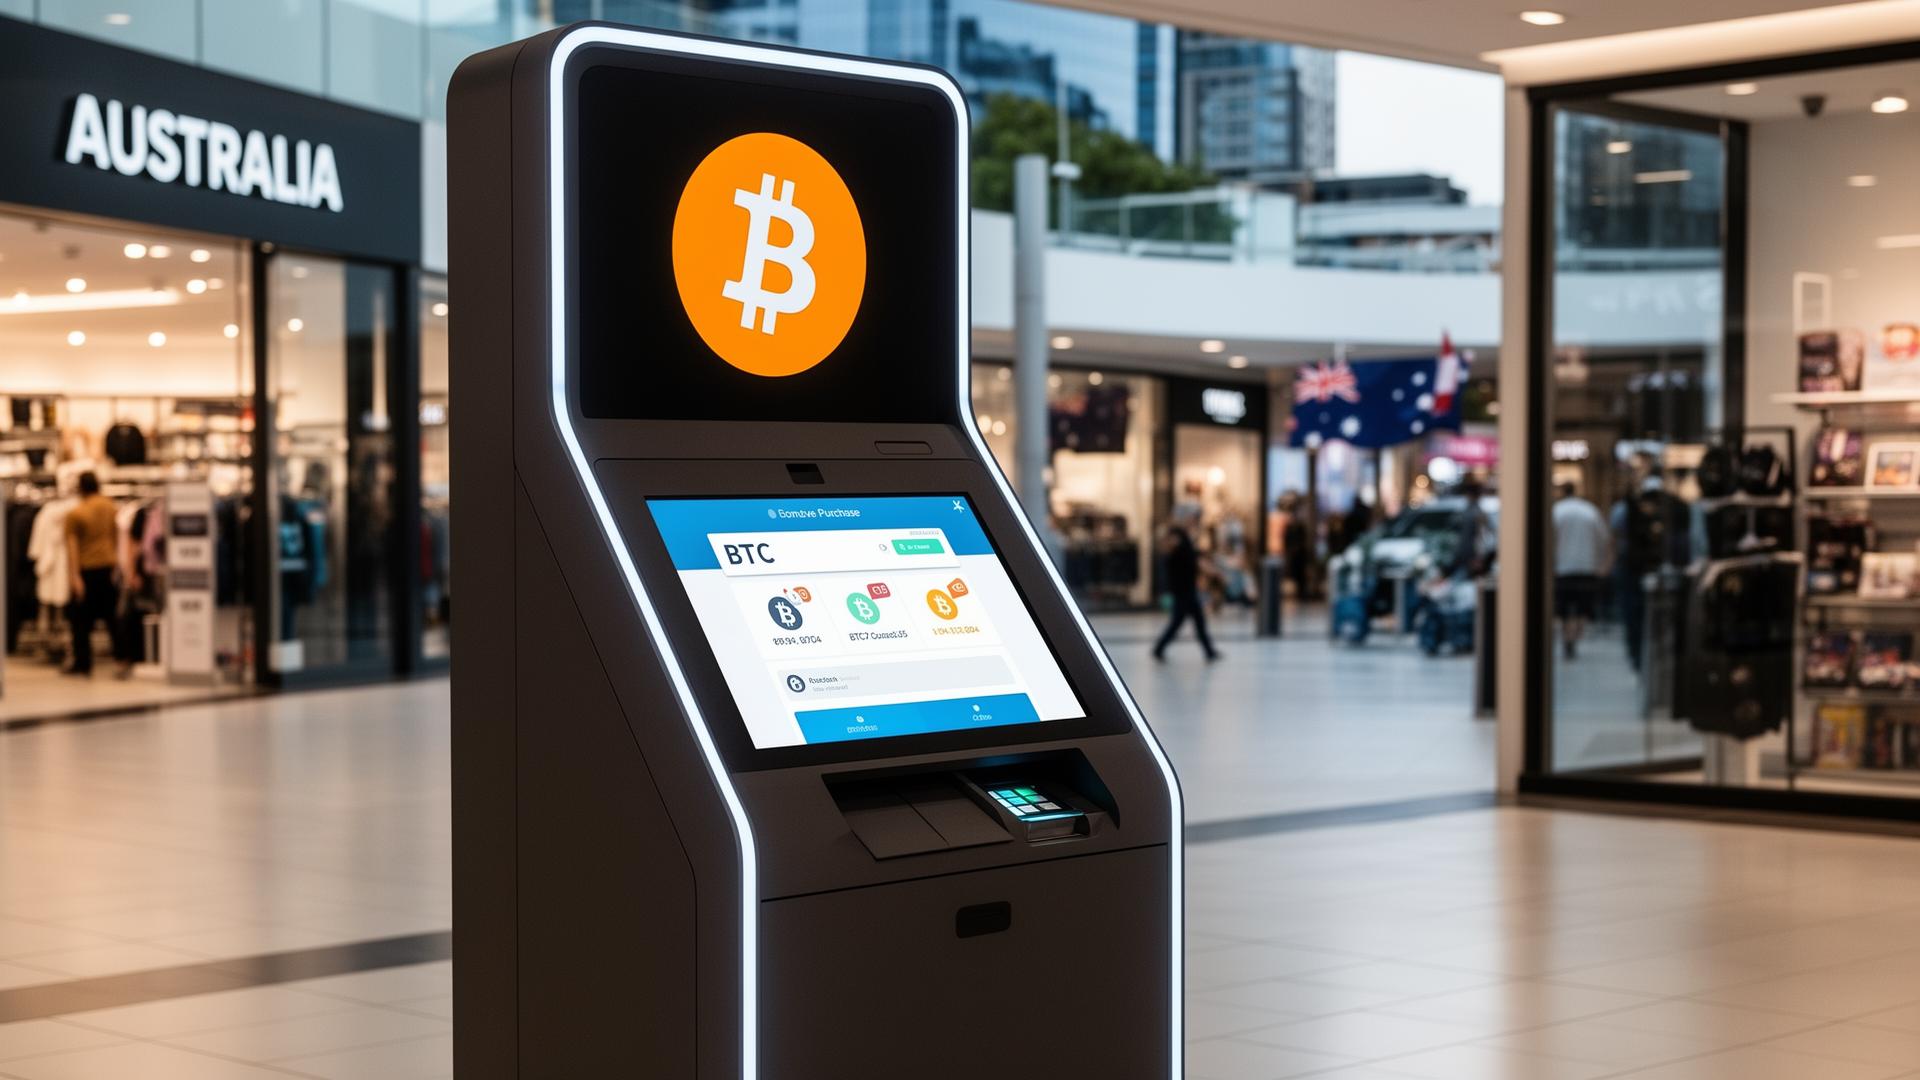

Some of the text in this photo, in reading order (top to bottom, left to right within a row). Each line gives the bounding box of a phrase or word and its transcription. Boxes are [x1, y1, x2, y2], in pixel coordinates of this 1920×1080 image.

[65, 93, 344, 213] AUSTRALIA
[817, 508, 861, 518] Purchase
[723, 542, 776, 565] BTC
